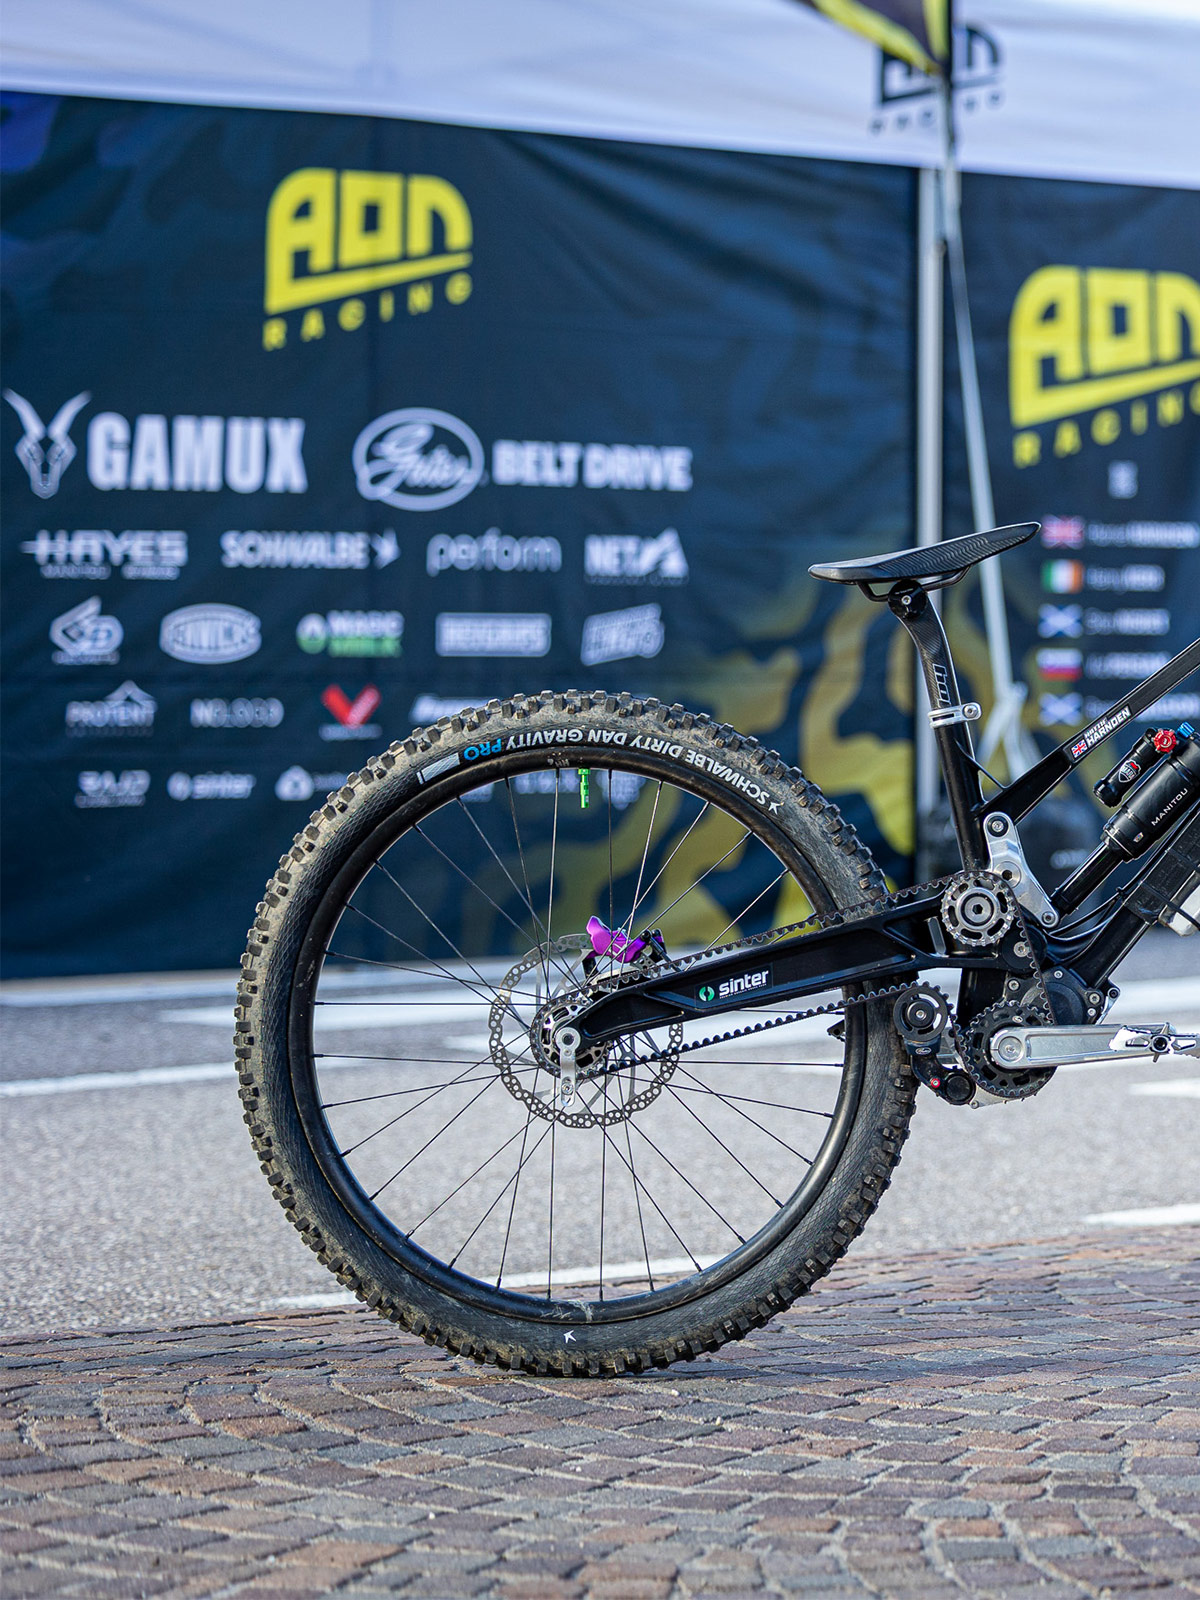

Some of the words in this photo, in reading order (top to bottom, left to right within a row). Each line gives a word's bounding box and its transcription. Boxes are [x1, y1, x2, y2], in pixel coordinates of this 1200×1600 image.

[262, 271, 472, 352] RACING
[87, 412, 308, 494] GAMUX
[492, 439, 583, 488] BELT
[582, 442, 693, 492] DRIVE
[24, 529, 189, 567] HAYES
[504, 728, 584, 751] GRAVITY
[587, 729, 629, 747] DAN
[1086, 705, 1131, 748] HARNDEN
[463, 738, 503, 761] PRO
[628, 733, 685, 760] DIRTY
[685, 749, 771, 805] SCHWALBE
[1151, 787, 1189, 826] MANITOU
[719, 970, 769, 996] sinter
